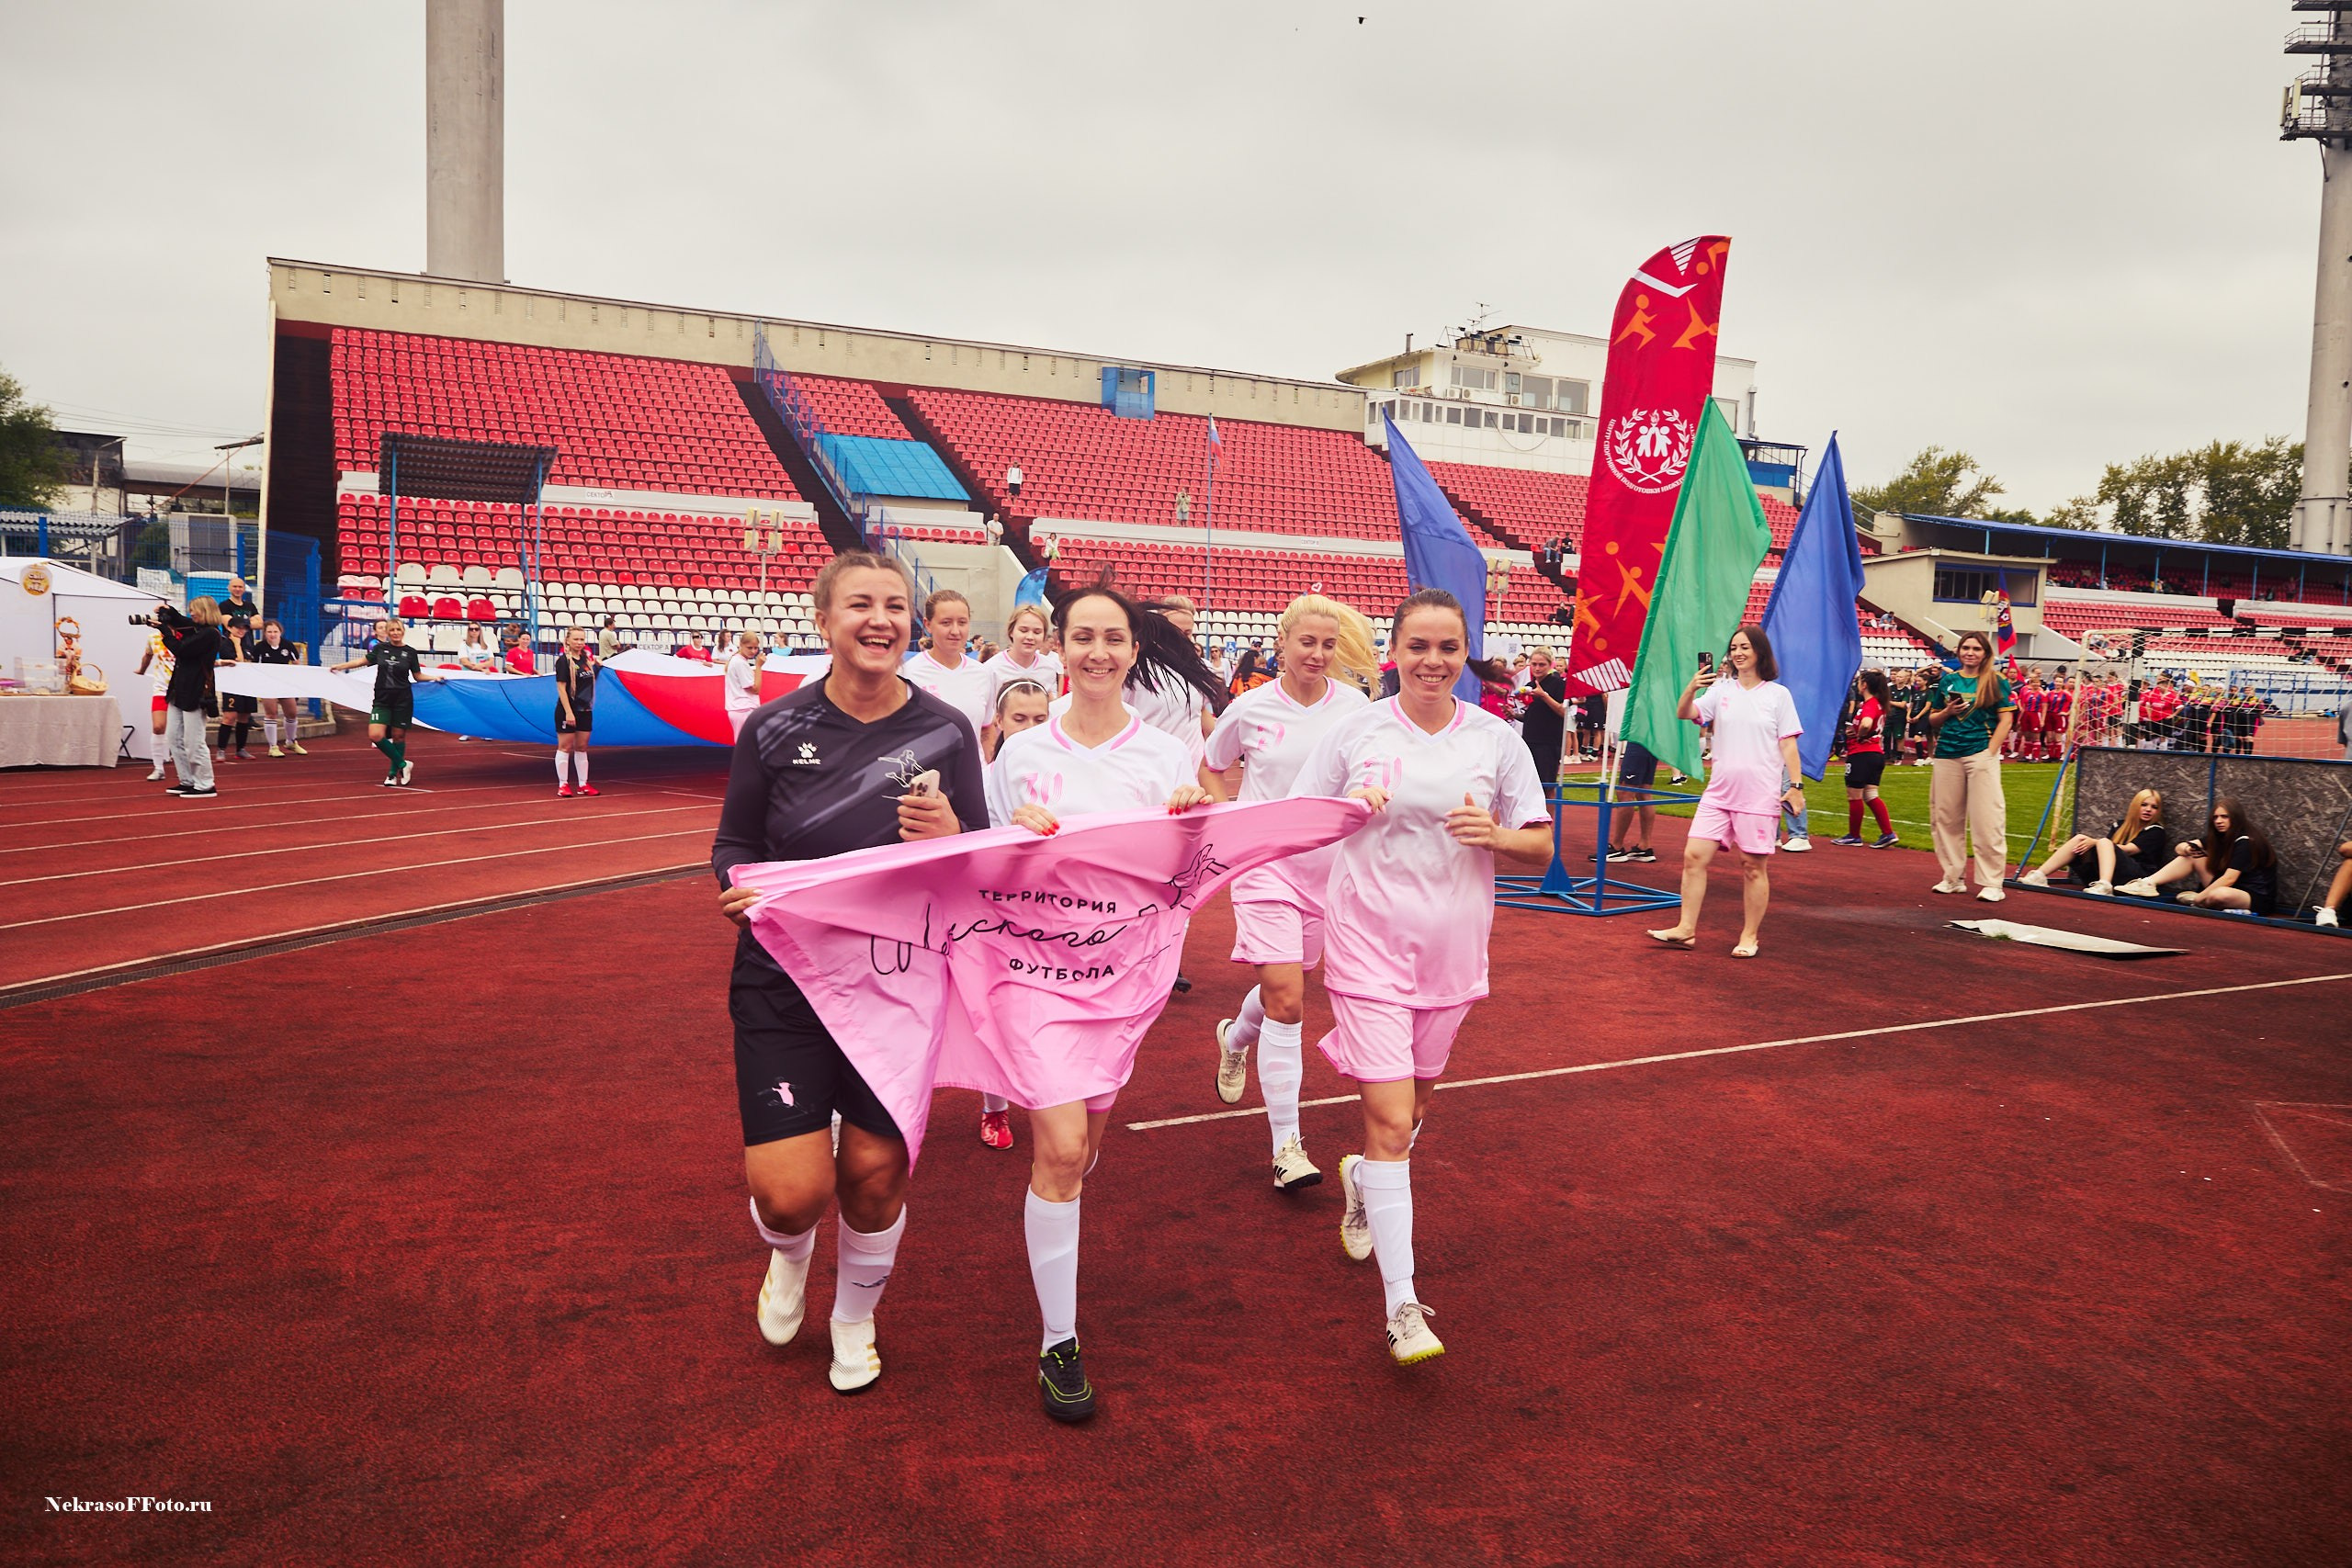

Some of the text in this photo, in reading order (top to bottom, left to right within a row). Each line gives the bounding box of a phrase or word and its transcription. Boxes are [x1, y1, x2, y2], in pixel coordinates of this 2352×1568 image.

[1604, 419, 1617, 440] ЦЕНТР
[1603, 441, 1623, 479] СПОРТИВНОЙ
[1621, 477, 1661, 494] ПОДГОТОВКИ
[228, 698, 235, 708] 2
[978, 889, 1116, 914] ТЕРРИТОРИЯ
[1010, 958, 1114, 982] ФУТБОЛА
